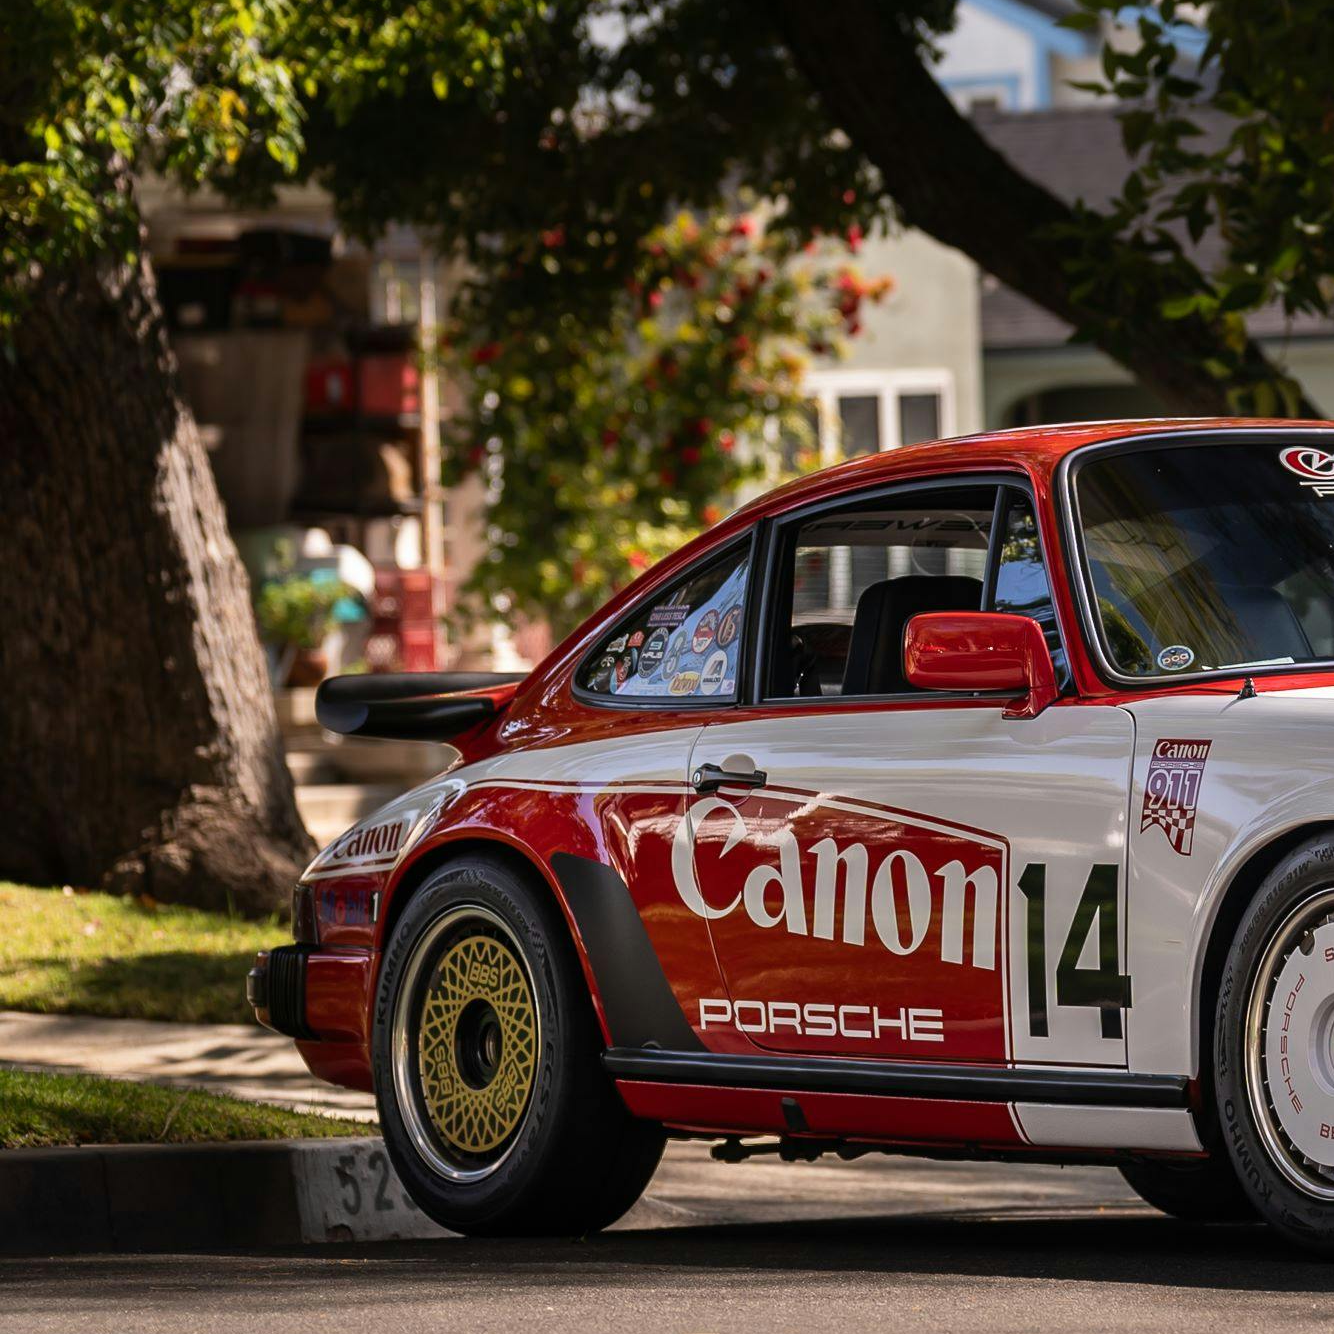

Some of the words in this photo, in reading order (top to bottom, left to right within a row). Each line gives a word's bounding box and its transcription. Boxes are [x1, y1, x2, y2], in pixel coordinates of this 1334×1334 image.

[1155, 741, 1208, 759] Canon
[1148, 769, 1200, 809] 911
[333, 822, 403, 860] Canon
[671, 797, 998, 971] Canon
[377, 922, 411, 1026] KUMHO
[469, 961, 500, 988] BBS
[1017, 864, 1134, 1040] 14
[699, 998, 944, 1042] PORSCHE
[1280, 973, 1305, 1114] PORSCHE
[434, 1045, 453, 1097] BBS
[494, 1066, 518, 1114] BBS
[1224, 1099, 1273, 1202] KUMHO
[333, 1151, 418, 1215] 52
